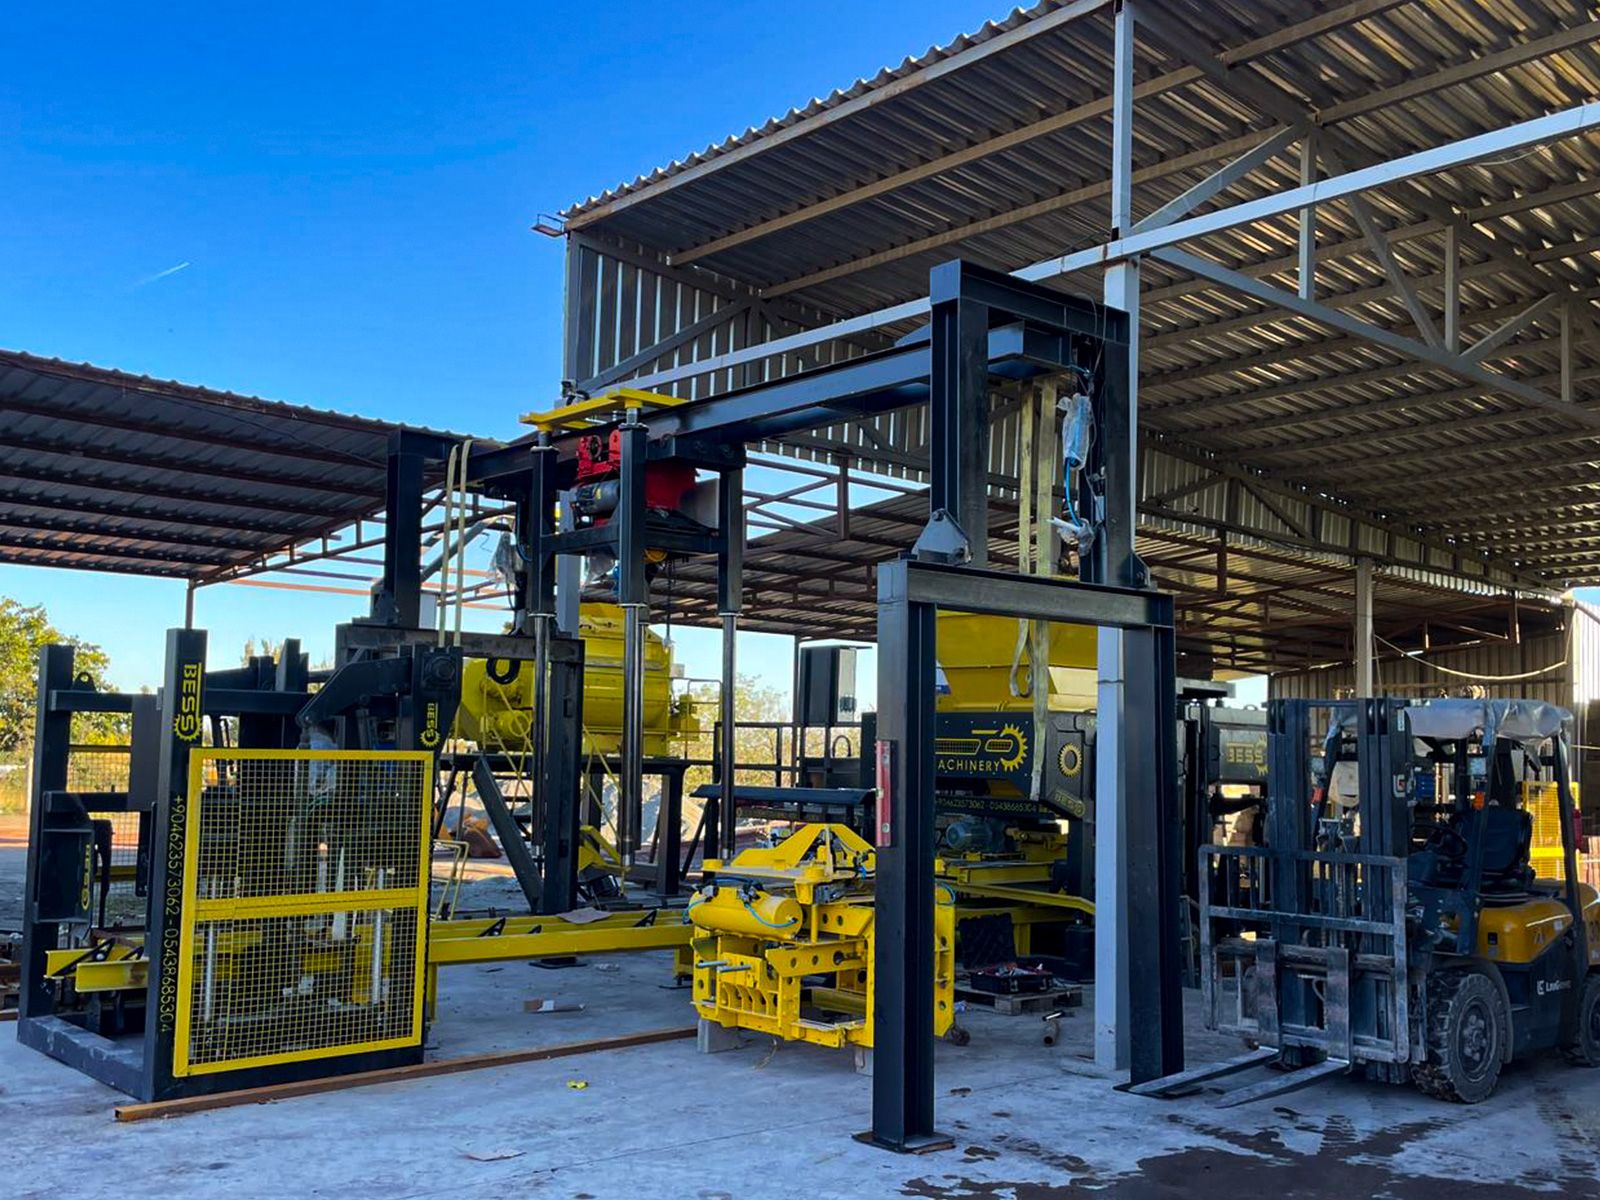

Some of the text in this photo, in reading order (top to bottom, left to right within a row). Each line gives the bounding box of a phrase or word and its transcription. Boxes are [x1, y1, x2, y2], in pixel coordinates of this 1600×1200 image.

[181, 664, 198, 732] BESS
[937, 758, 1001, 772] ACHINERY
[164, 795, 186, 915] +904623573062
[160, 928, 179, 1032] 05438685304
